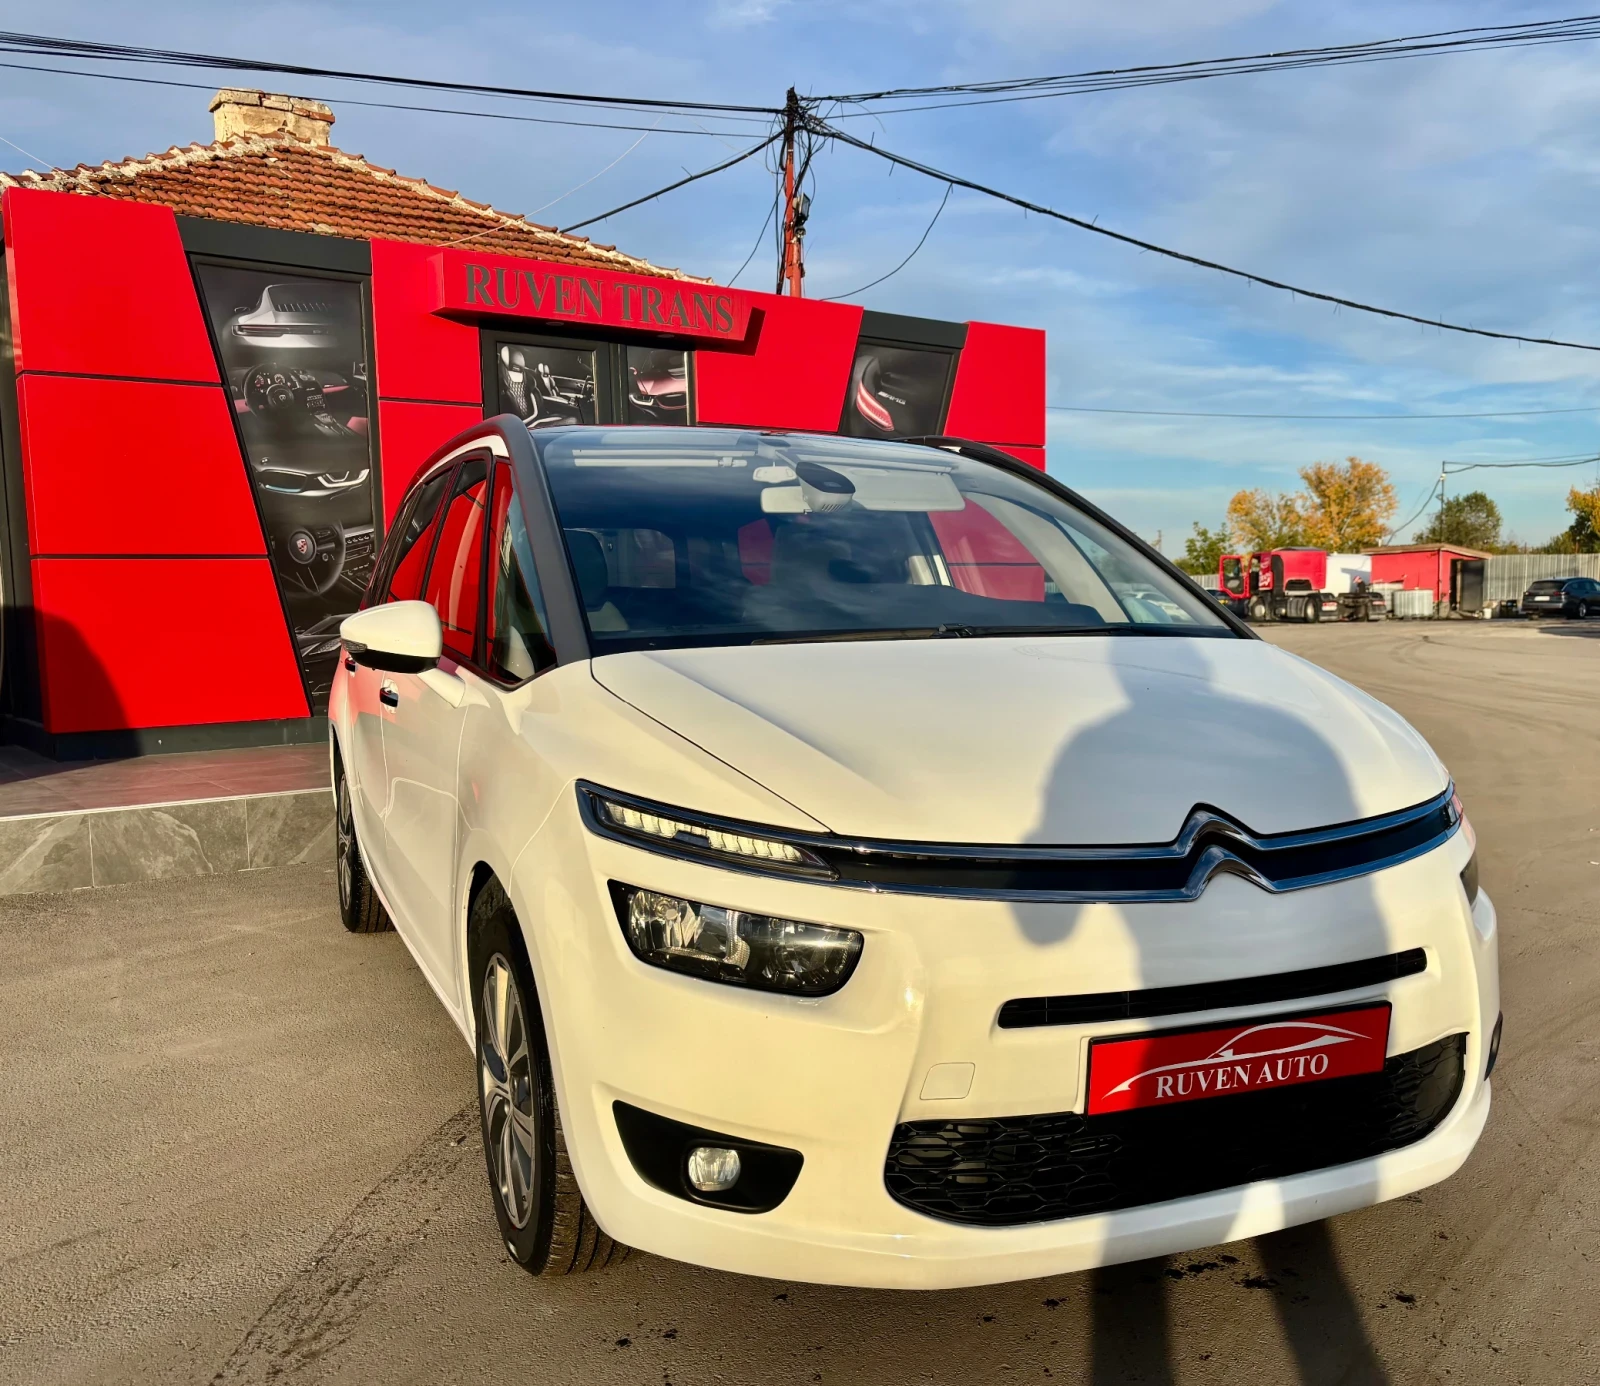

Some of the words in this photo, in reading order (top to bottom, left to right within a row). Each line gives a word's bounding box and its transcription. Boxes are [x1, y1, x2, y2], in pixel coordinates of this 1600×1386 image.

[464, 263, 603, 318] RUVEN
[614, 282, 734, 333] TRANS
[1154, 1064, 1252, 1099] RUVEN
[1256, 1053, 1329, 1085] AUTO
